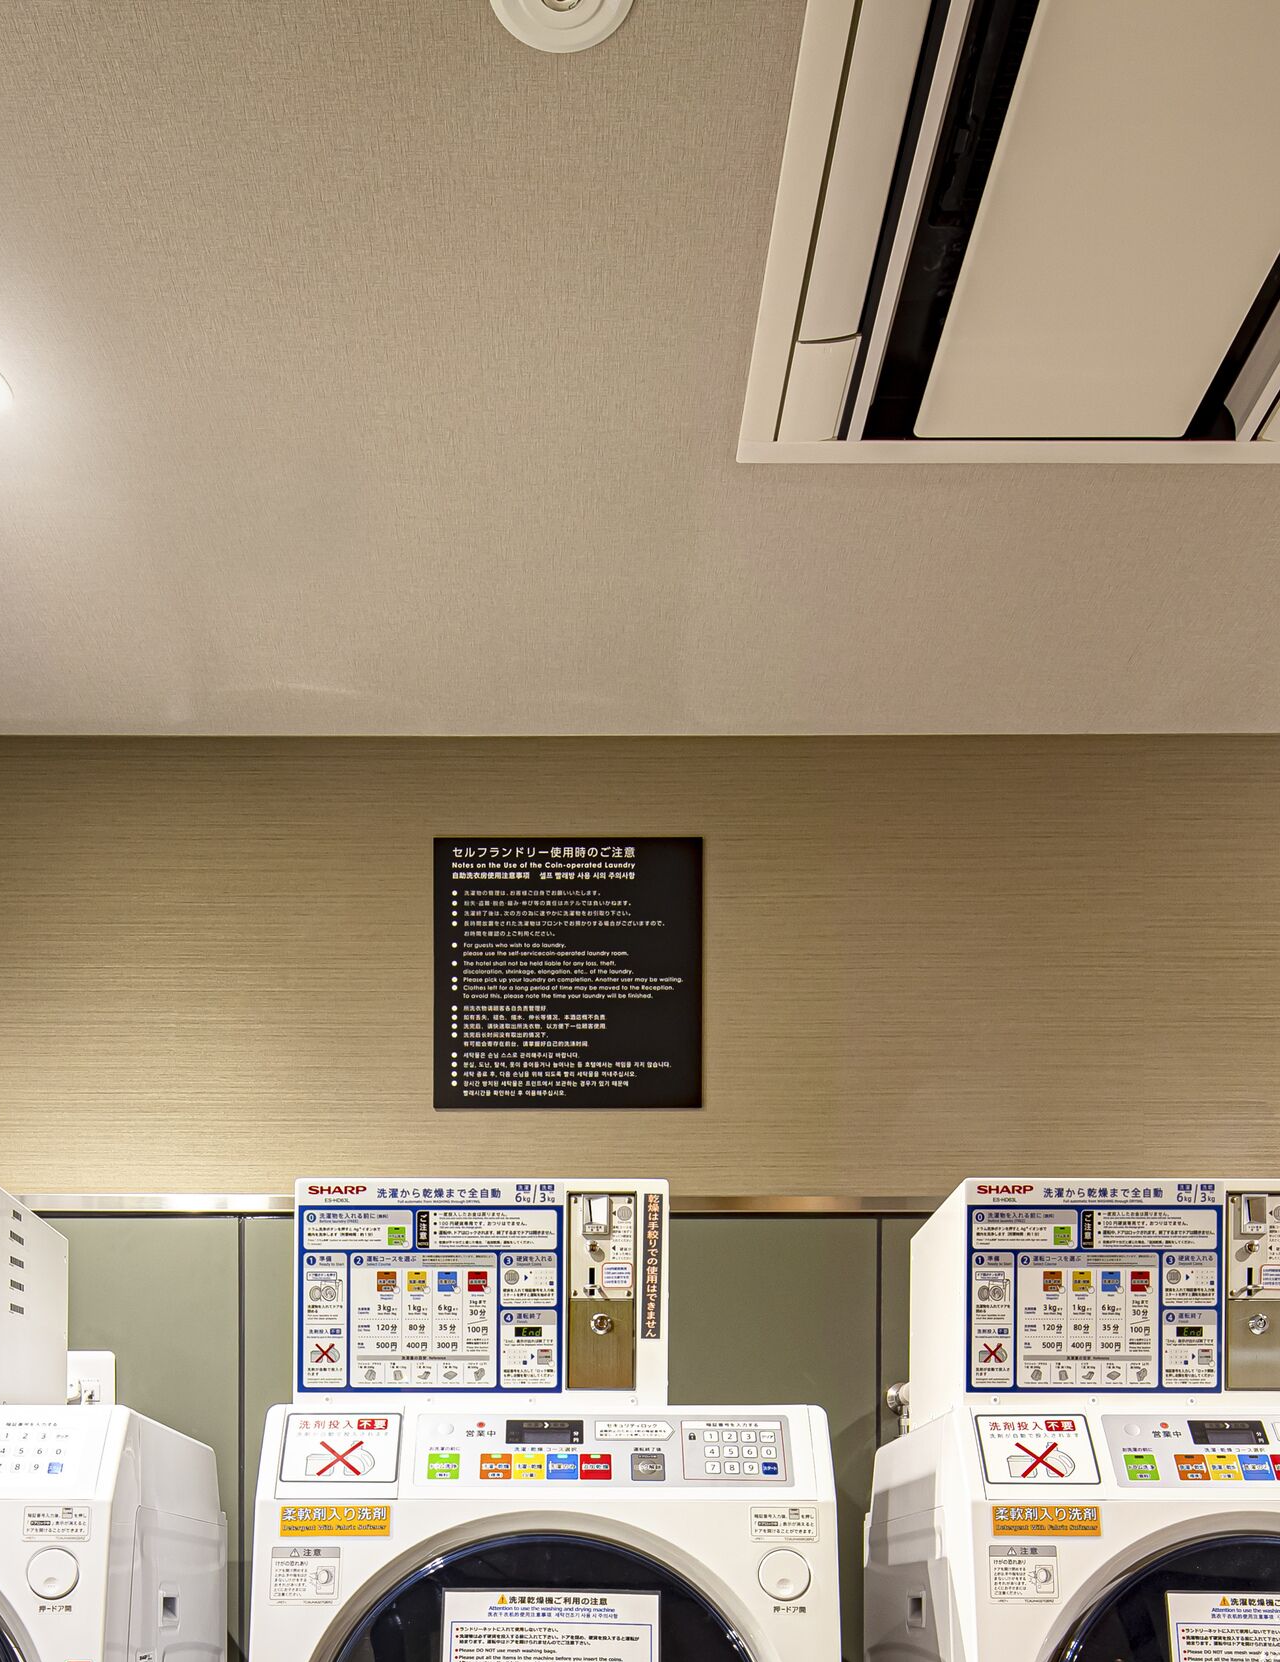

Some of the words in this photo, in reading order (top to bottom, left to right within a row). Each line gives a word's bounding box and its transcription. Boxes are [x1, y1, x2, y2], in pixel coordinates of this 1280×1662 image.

[452, 846, 636, 858] セルフランドリー使用時のご注意
[605, 862, 635, 870] Laundry
[308, 1186, 367, 1195] SHARP
[377, 1188, 501, 1199] 洗濯から乾燥まで全自動
[976, 1184, 1034, 1195] SHARP
[1042, 1185, 1164, 1199] 洗濯から乾燥まで全自動
[646, 1194, 658, 1338] 乾燥は手絞りでの使用はできません
[298, 1419, 353, 1430] 洗剤投入
[358, 1419, 388, 1430] 不要
[988, 1421, 1043, 1431] 洗剤投入
[1046, 1421, 1075, 1431] 不要
[466, 1430, 496, 1438] 営業中
[282, 1507, 387, 1521] 柔軟剤入り洗剤
[994, 1507, 1097, 1522] 柔軟剤入り洗剤
[303, 1548, 322, 1557] 注意
[509, 1596, 608, 1606] 洗濯乾燥機ご利用の注意
